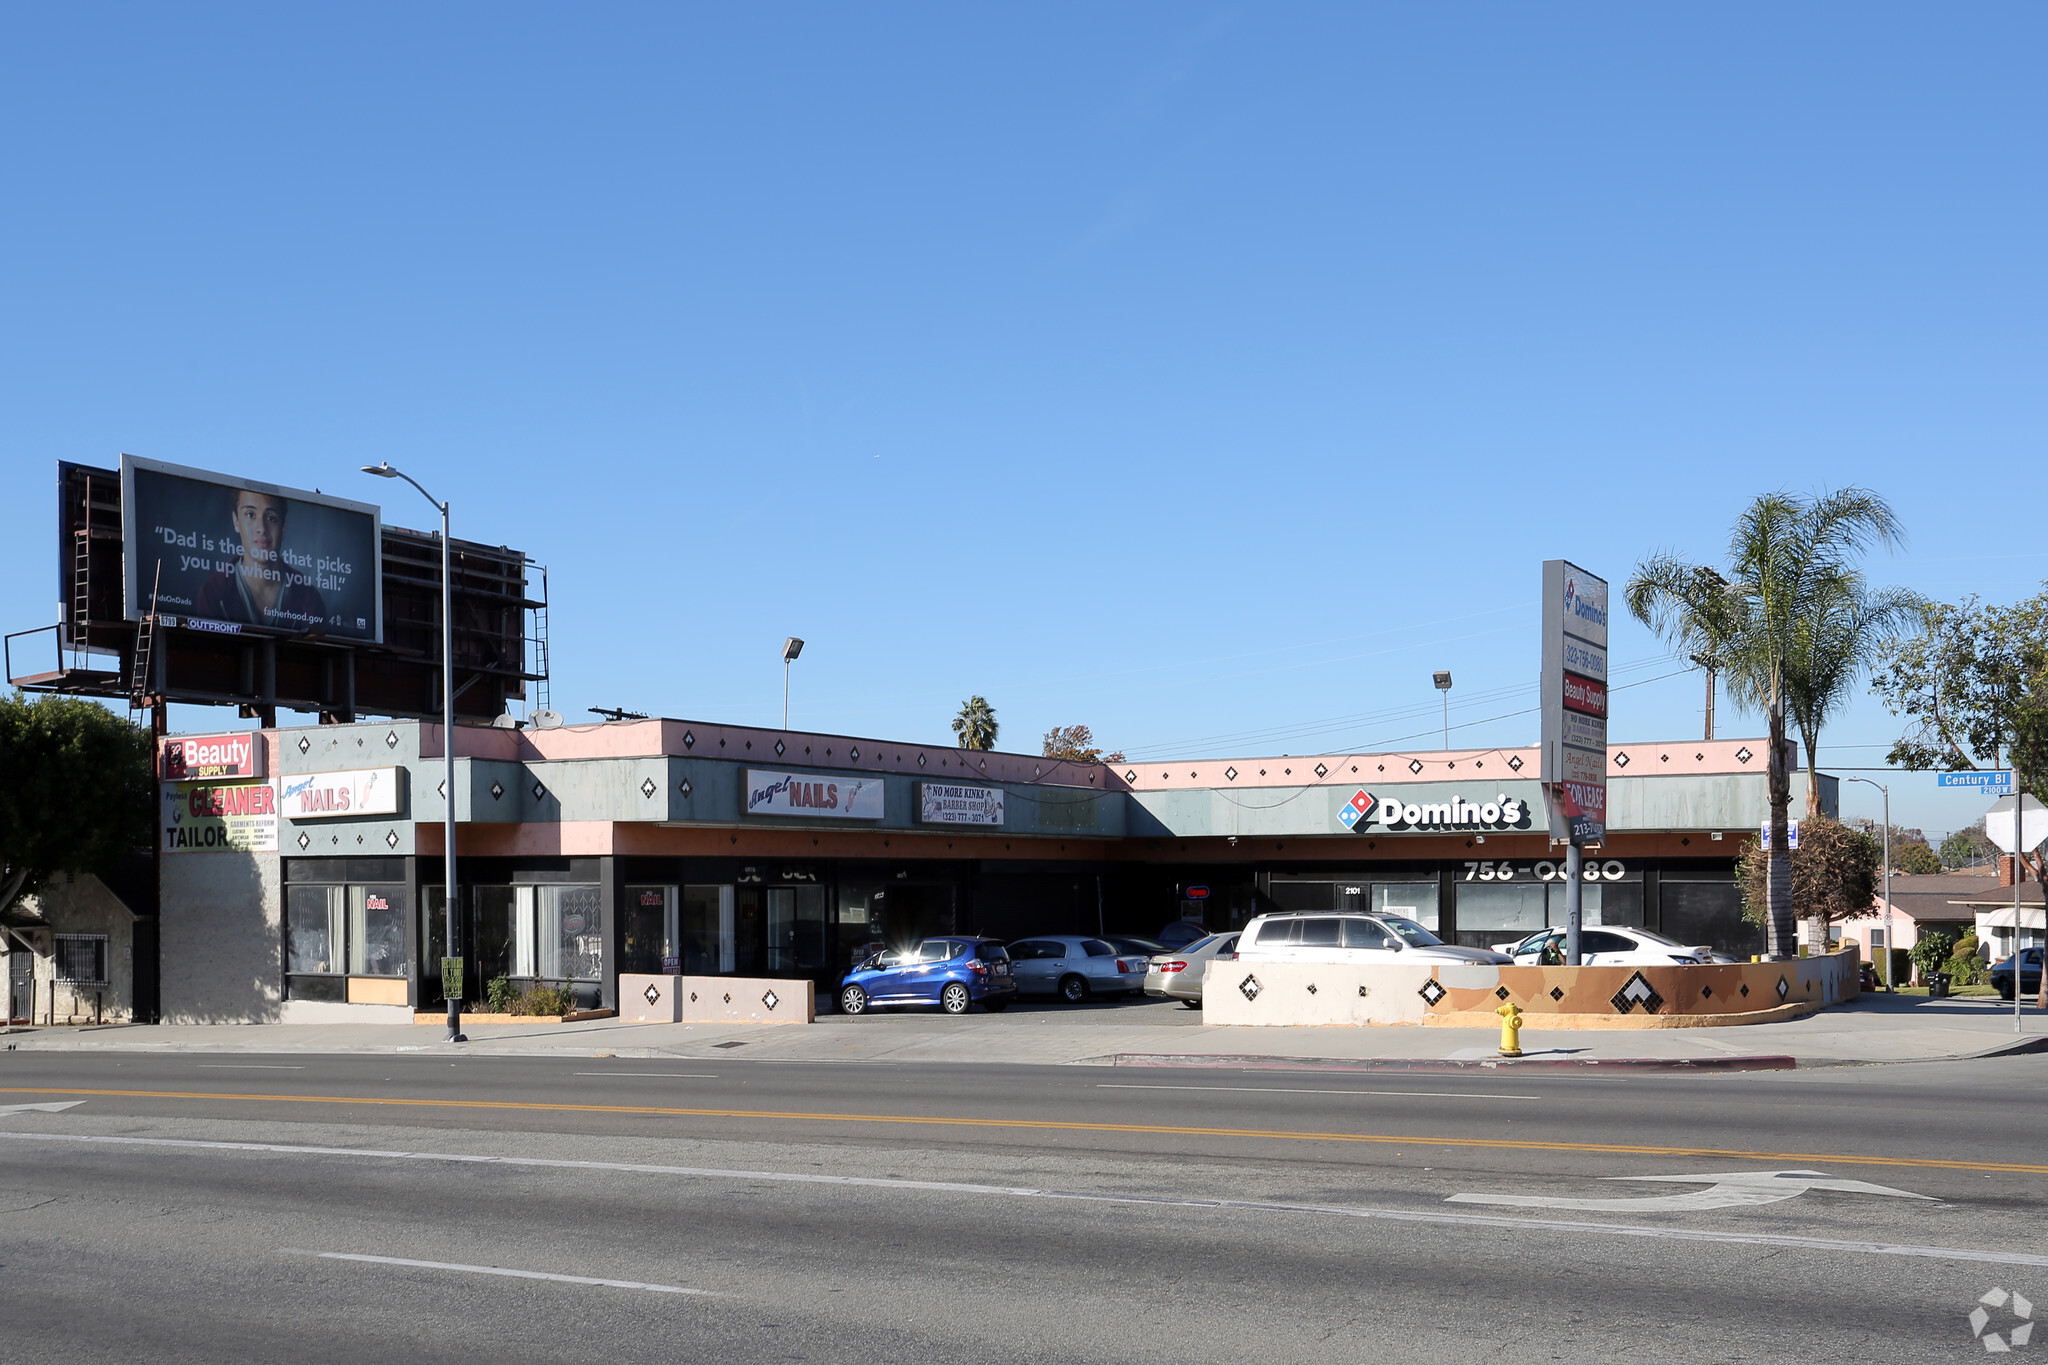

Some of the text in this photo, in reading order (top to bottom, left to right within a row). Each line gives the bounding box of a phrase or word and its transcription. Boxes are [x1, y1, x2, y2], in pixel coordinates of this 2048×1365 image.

[202, 534, 214, 551] is
[219, 537, 245, 556] the
[250, 547, 278, 562] one
[282, 548, 312, 568] that
[317, 555, 352, 575] picks
[181, 555, 210, 571] you
[215, 561, 235, 578] up
[240, 562, 280, 582] when
[285, 572, 312, 588] you
[263, 606, 324, 625] fatherhood.gov
[1574, 594, 1607, 627] Domino's
[189, 619, 239, 634] OUTFRONT
[1564, 678, 1606, 712] Beauty Supply
[185, 739, 250, 769] Beauty
[1565, 752, 1604, 770] Angel Nails
[198, 765, 228, 776] SUPPLY
[1945, 774, 1990, 786] Century
[281, 776, 315, 799] Angel
[748, 775, 792, 809] Angel
[789, 781, 838, 809] NAILS
[932, 786, 985, 799] NO MORE KINKS
[1582, 785, 1604, 810] LEASE
[1983, 786, 2001, 794] 2100
[189, 786, 275, 818] CLEANER
[300, 787, 350, 812] NAILS
[943, 799, 985, 812] BARBER SHOP
[1378, 793, 1522, 825] Domino's
[942, 812, 957, 822] (323)
[958, 813, 968, 821] 777
[166, 826, 229, 848] TAILOR
[641, 894, 663, 906] NAIL
[1345, 886, 1360, 895] 2101
[367, 898, 389, 910] NAIL
